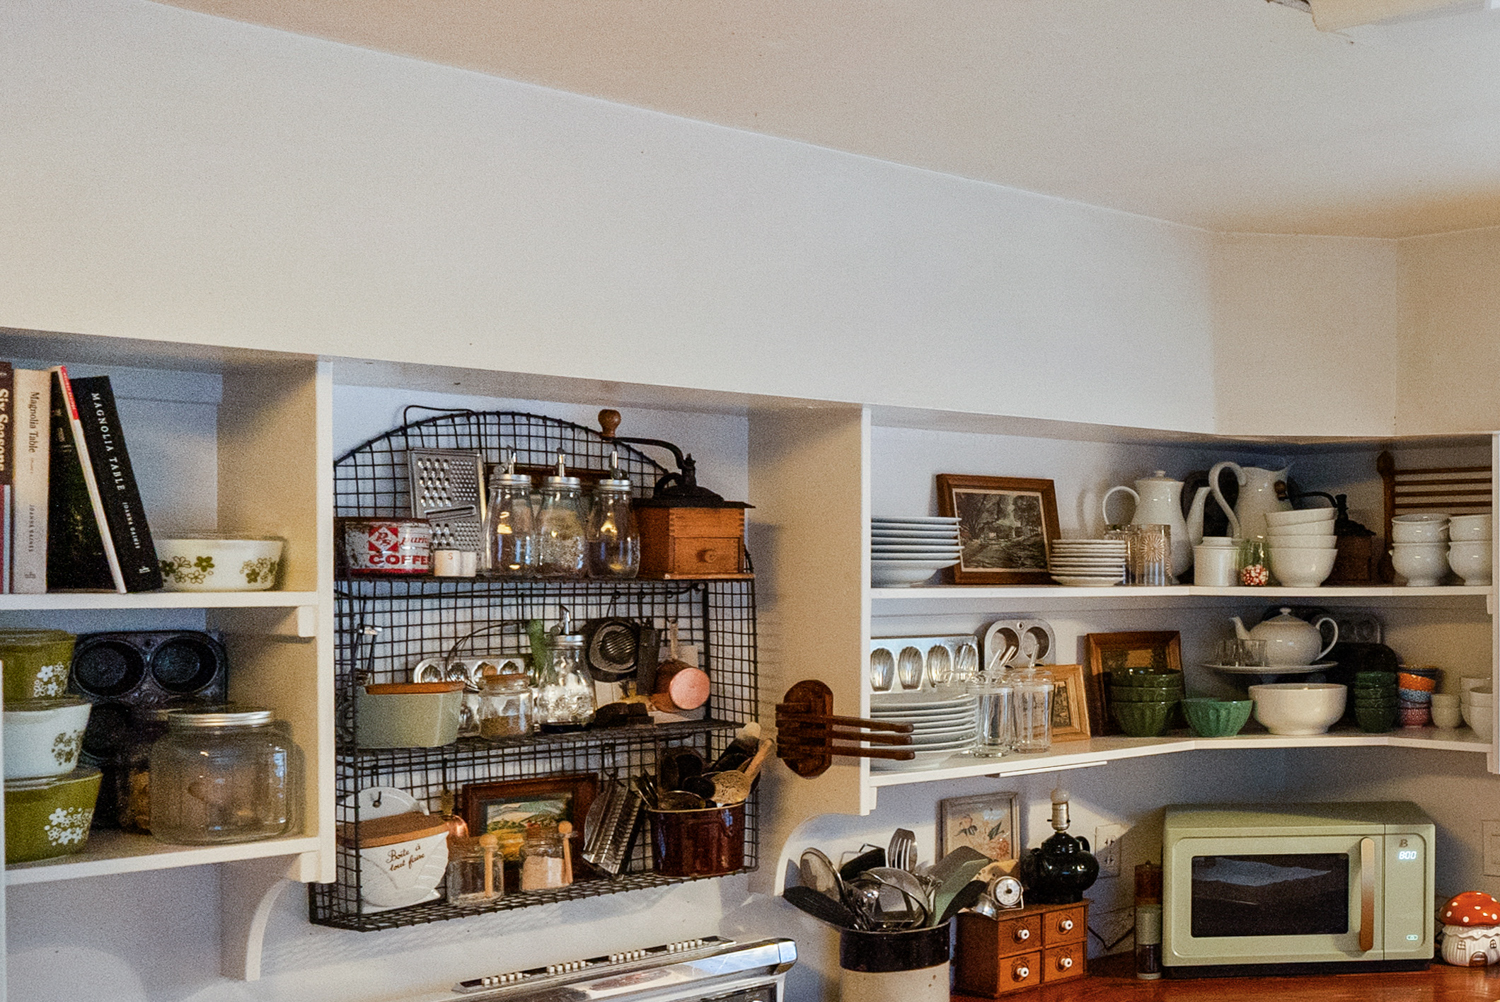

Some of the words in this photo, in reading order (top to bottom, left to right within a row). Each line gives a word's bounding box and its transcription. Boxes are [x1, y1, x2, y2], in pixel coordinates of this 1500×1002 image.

[28, 391, 40, 429] Magnolia
[28, 430, 39, 454] Table
[91, 392, 114, 452] MAGNOLIA
[108, 456, 126, 492] TABLE
[122, 502, 134, 525] JOANNA
[130, 527, 141, 550] GAINES
